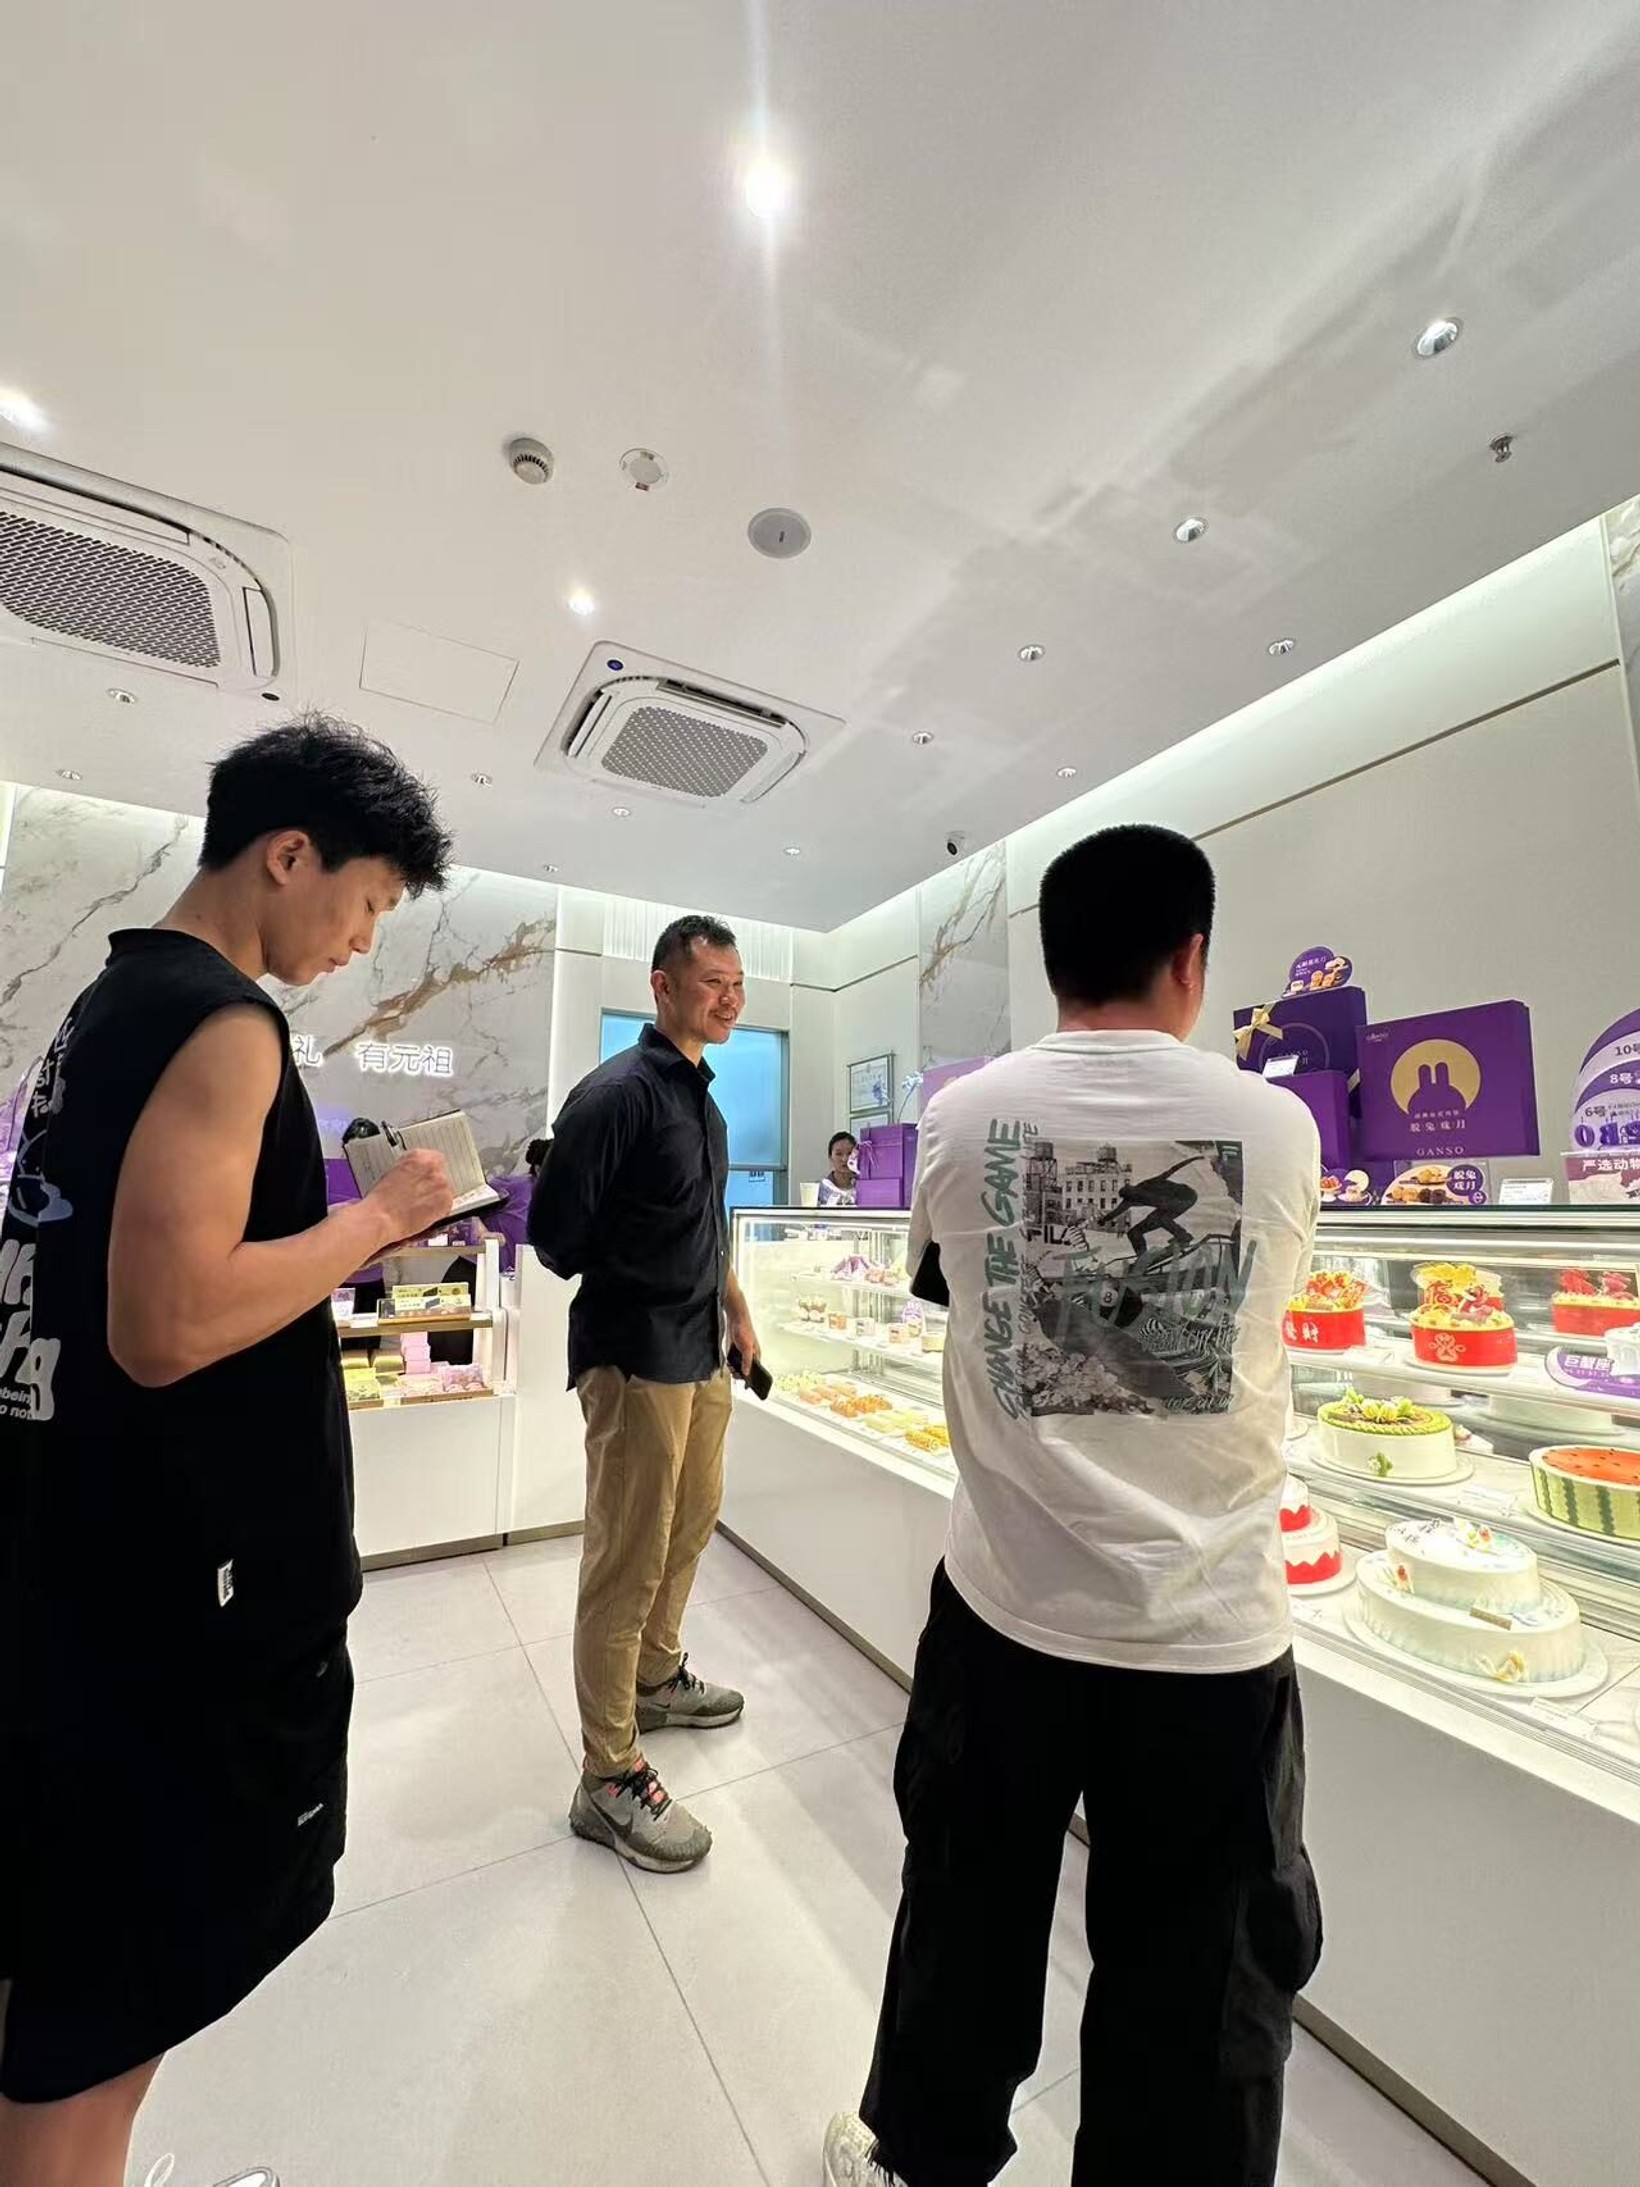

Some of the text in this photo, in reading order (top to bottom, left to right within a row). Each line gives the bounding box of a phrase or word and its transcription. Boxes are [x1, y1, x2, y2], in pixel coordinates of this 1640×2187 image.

[293, 1035, 453, 1076] 礼 有元祖
[1610, 1073, 1633, 1085] 8号
[1585, 1105, 1607, 1118] 6号
[1416, 1145, 1464, 1157] GANSO
[981, 1118, 1021, 1420] CHANGE THE GAME
[1564, 1354, 1612, 1371] 巨蟹座
